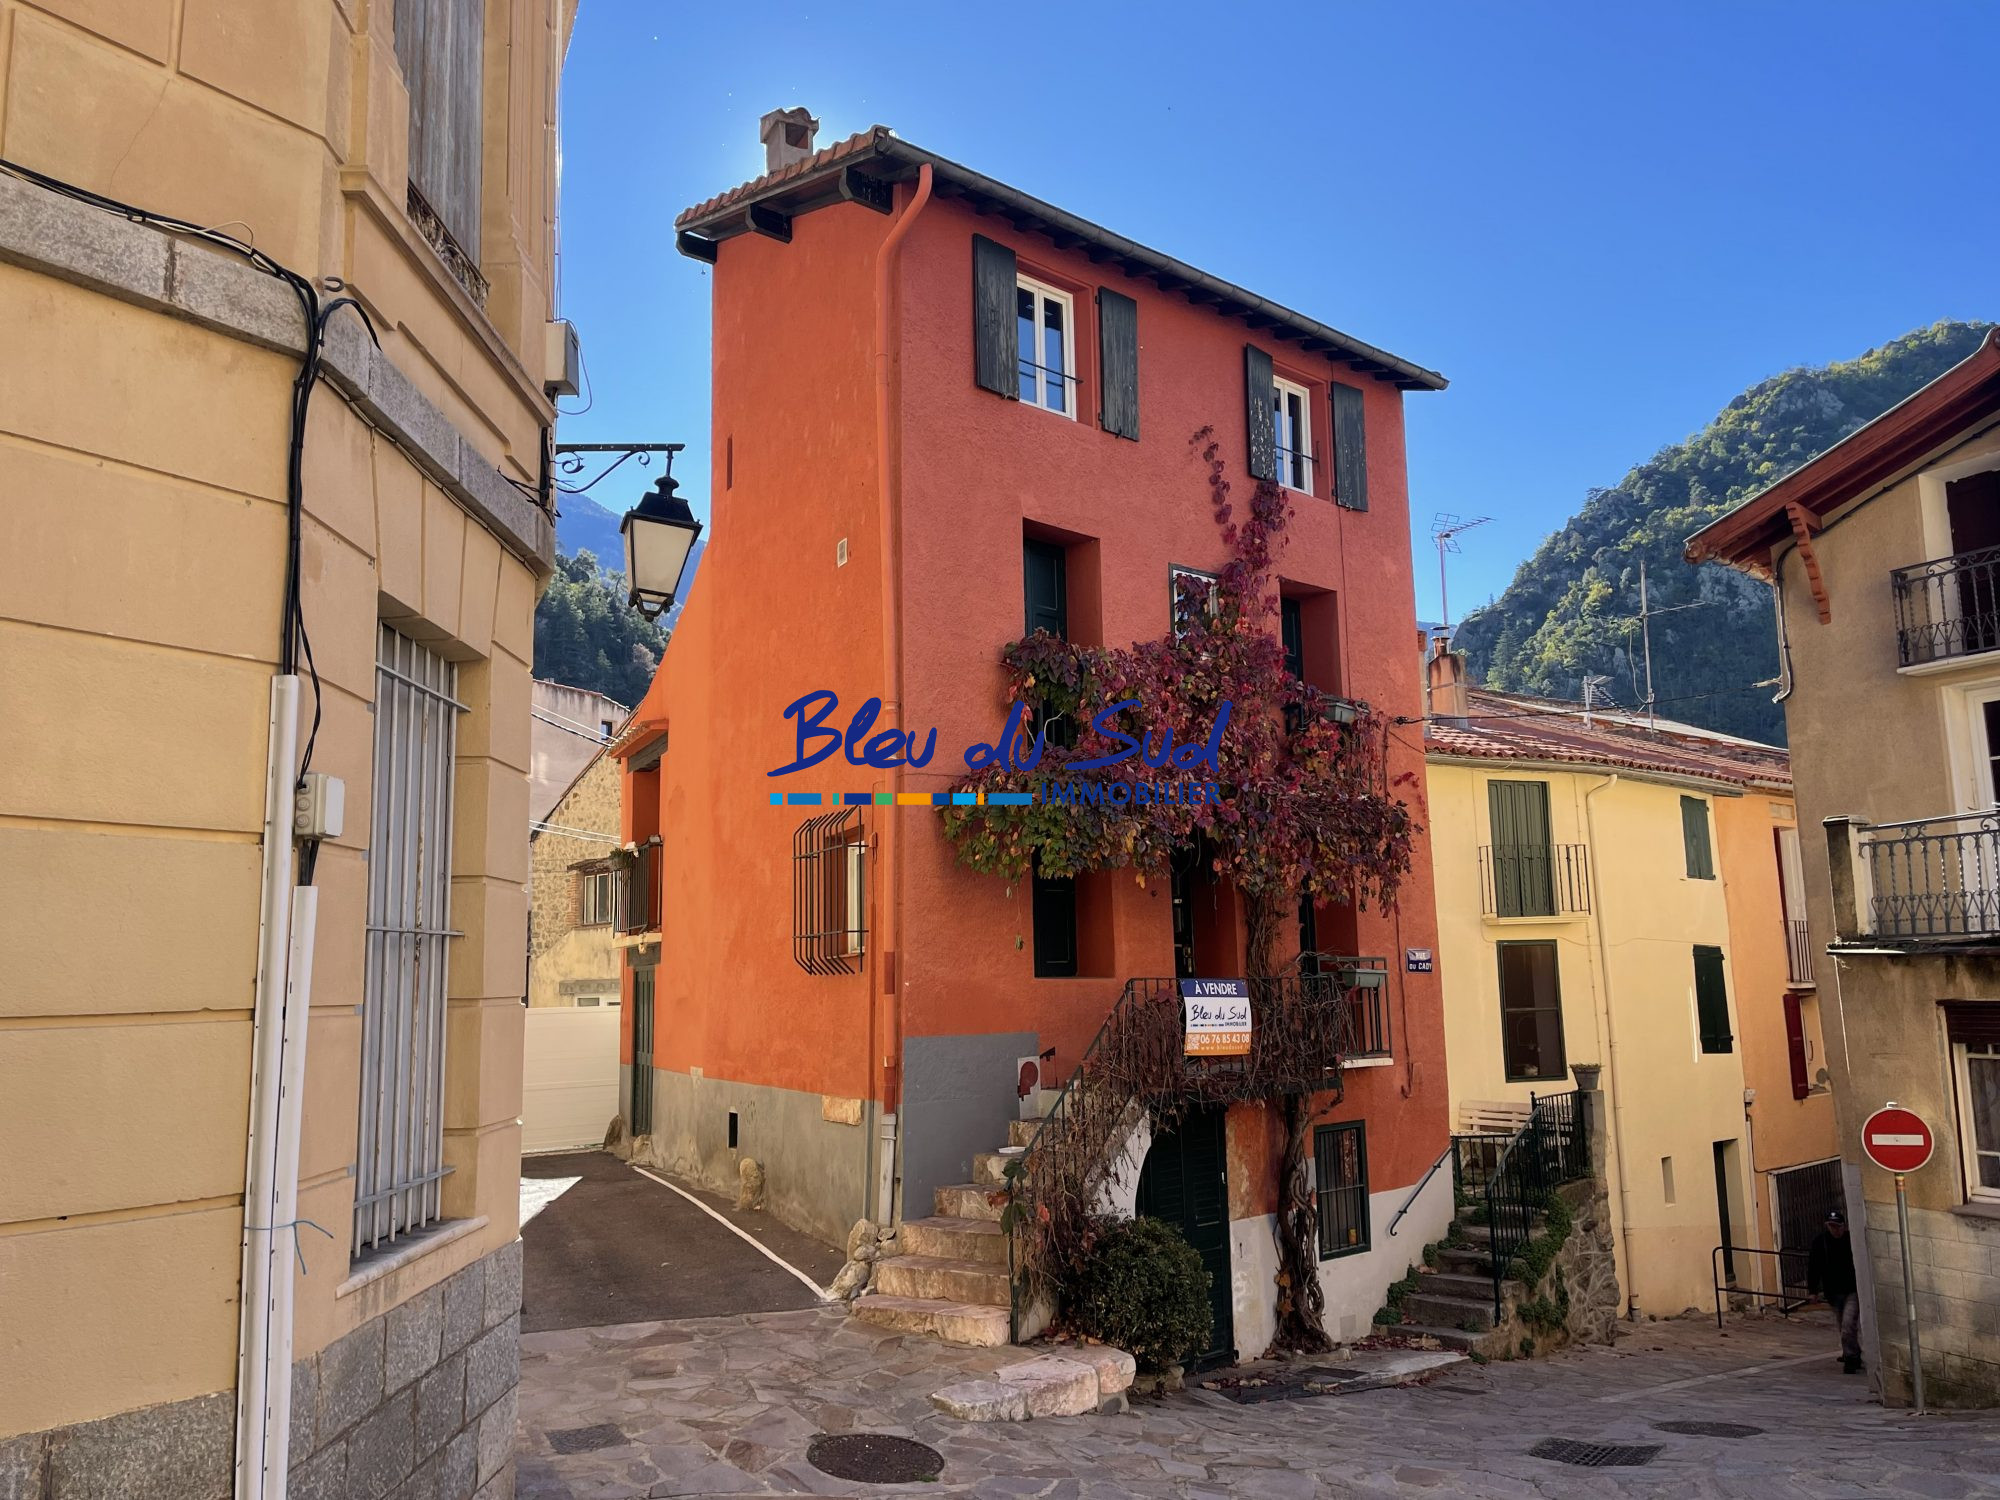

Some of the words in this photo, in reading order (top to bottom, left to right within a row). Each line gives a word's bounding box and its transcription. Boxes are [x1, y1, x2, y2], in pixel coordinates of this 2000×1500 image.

[1195, 981, 1202, 995] À
[1203, 983, 1238, 995] VENDRE
[1190, 1005, 1212, 1021] Bleu
[1215, 1007, 1225, 1020] du
[1228, 1007, 1247, 1020] Sud
[1200, 1034, 1210, 1044] 06
[1211, 1034, 1221, 1044] 76
[1222, 1034, 1231, 1044] 85
[1232, 1034, 1240, 1044] 43
[1241, 1033, 1250, 1044] 08
